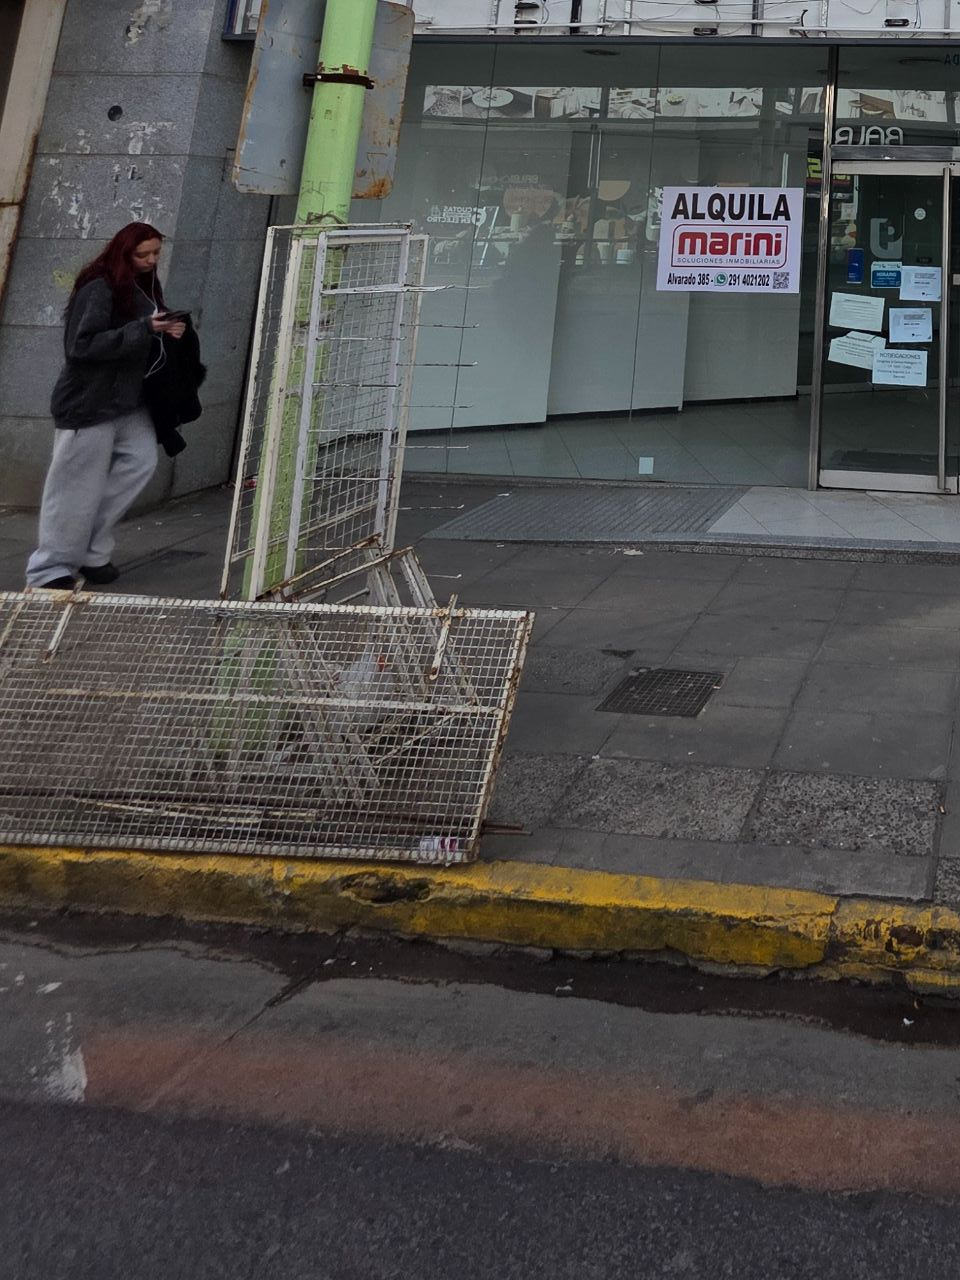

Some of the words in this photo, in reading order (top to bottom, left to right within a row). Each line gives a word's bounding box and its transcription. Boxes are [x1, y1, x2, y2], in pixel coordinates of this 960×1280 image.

[671, 193, 791, 222] ALQUILA
[678, 232, 782, 256] marini
[667, 273, 696, 285] Alvarado
[698, 273, 710, 286] 385
[728, 274, 740, 286] 291
[741, 274, 770, 287] 4021202
